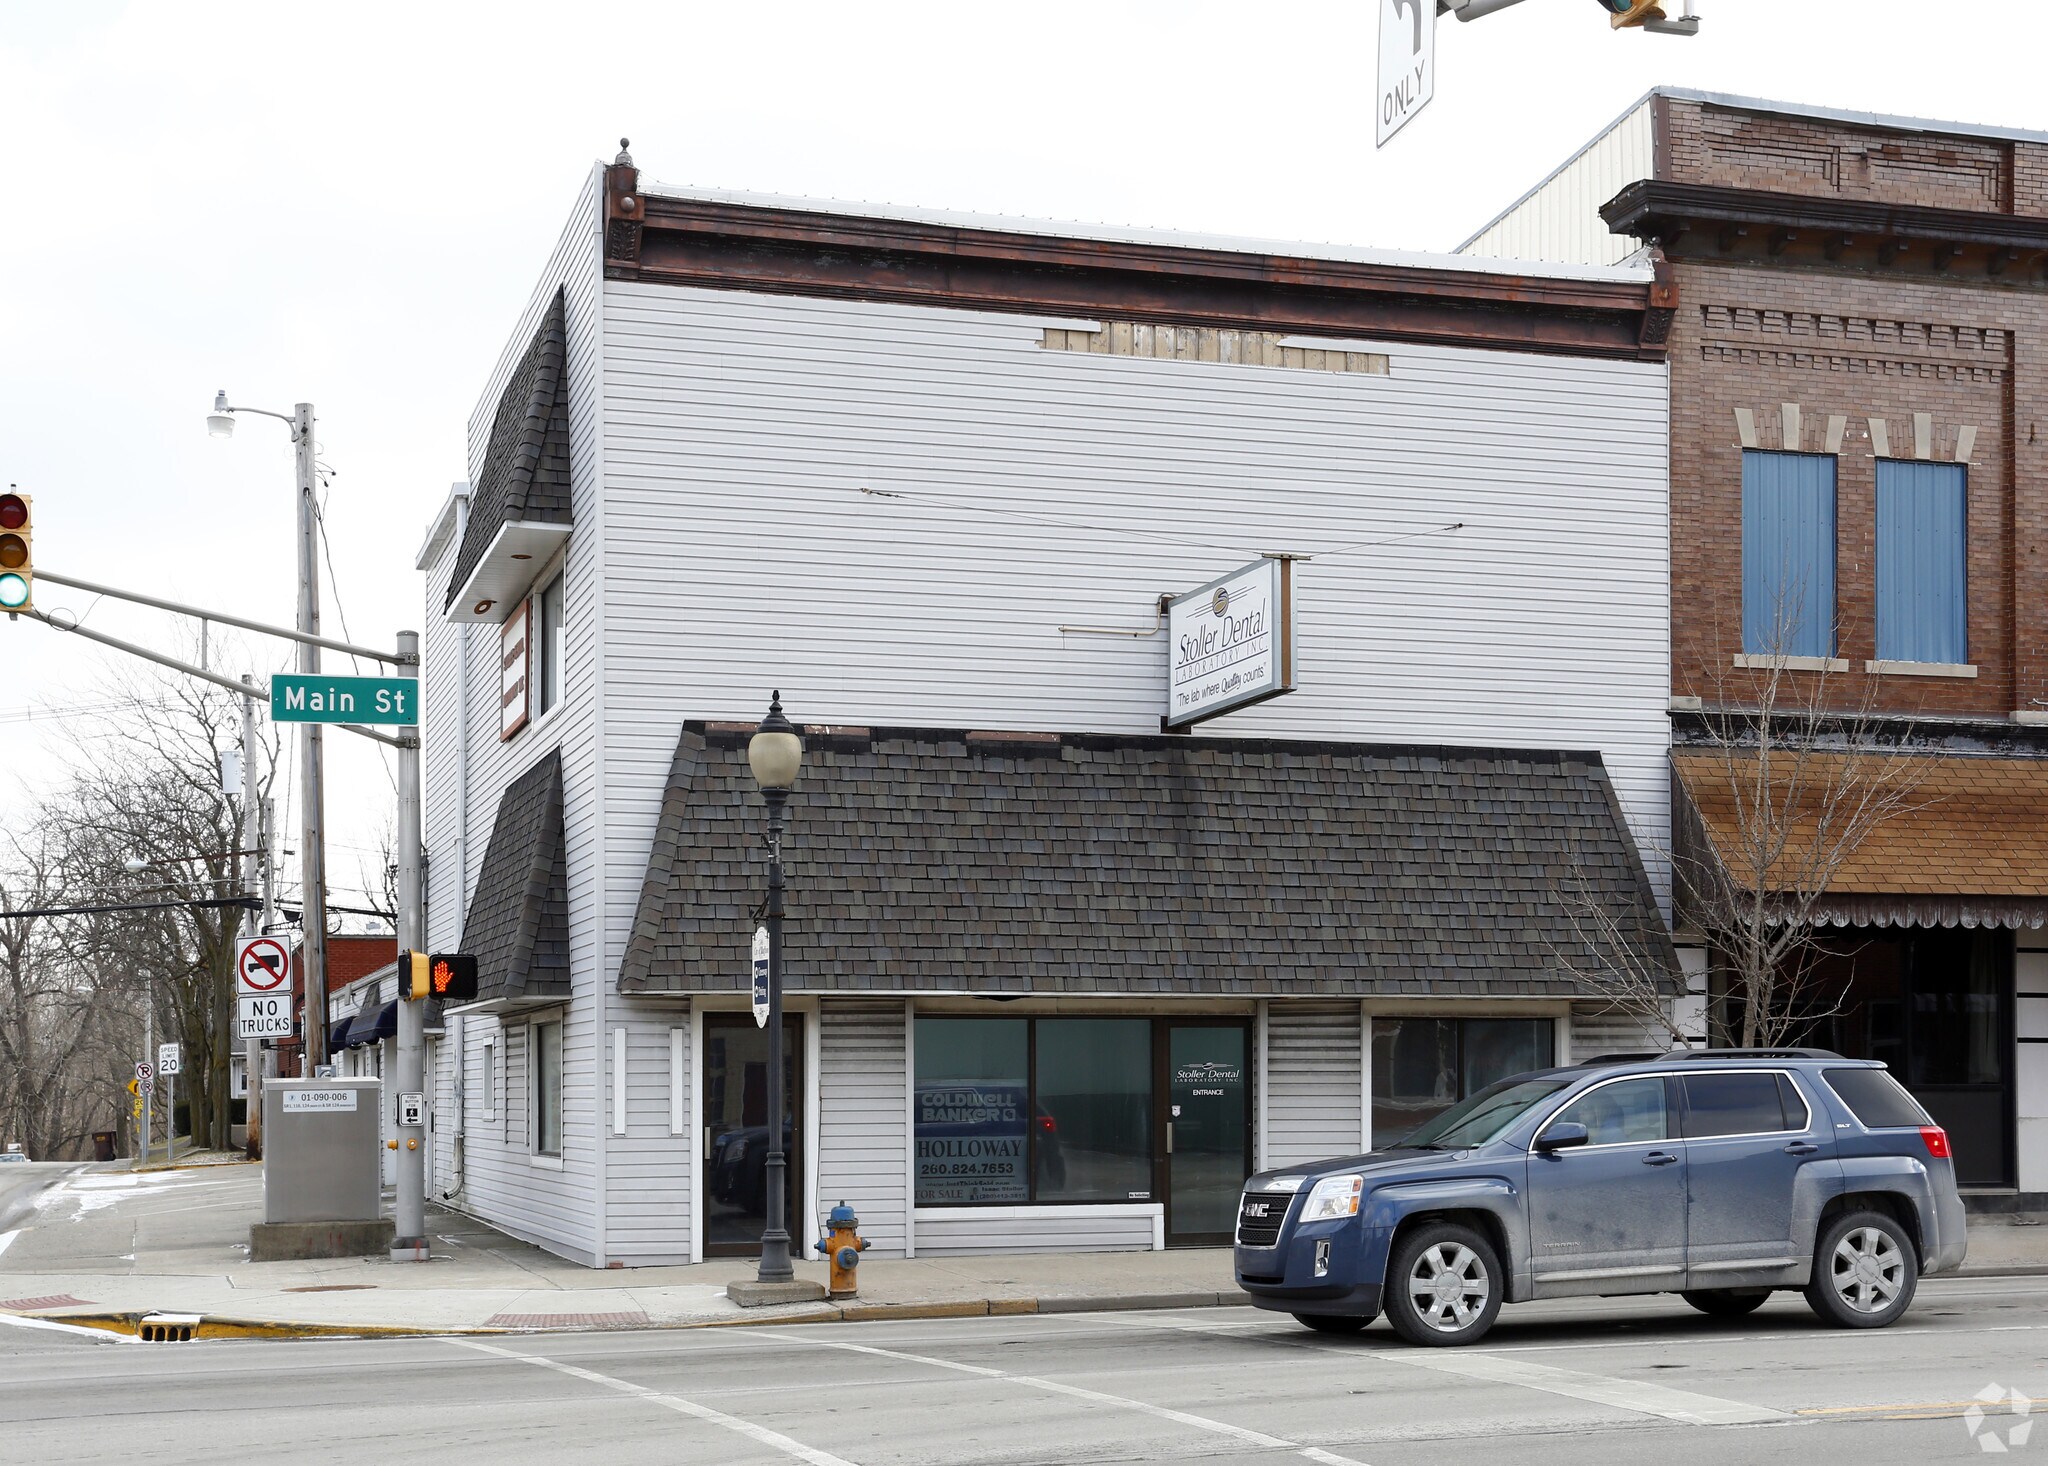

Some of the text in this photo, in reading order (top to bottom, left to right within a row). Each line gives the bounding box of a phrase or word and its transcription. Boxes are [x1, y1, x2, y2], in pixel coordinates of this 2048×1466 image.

[1384, 59, 1425, 125] ONLY
[1178, 598, 1266, 665] Stoller Dental
[1175, 637, 1268, 683] LABORATORY INC.
[1190, 688, 1200, 702] lab
[1201, 682, 1220, 699] where
[1221, 672, 1242, 693] Quality
[285, 686, 405, 713] Main St
[253, 1000, 278, 1016] NO
[241, 1017, 290, 1033] TRUCKS
[161, 1059, 177, 1071] 20
[1176, 1069, 1240, 1078] Stoller Dental
[301, 1093, 348, 1101] 01-090-006
[921, 1093, 1017, 1107] COLDWELL
[922, 1108, 1000, 1122] BANKER
[917, 1140, 1022, 1158] HOLLOWAY
[921, 1163, 1014, 1175] 260.824.7653
[938, 1189, 963, 1199] SALE
[1245, 1203, 1270, 1217] GMC
